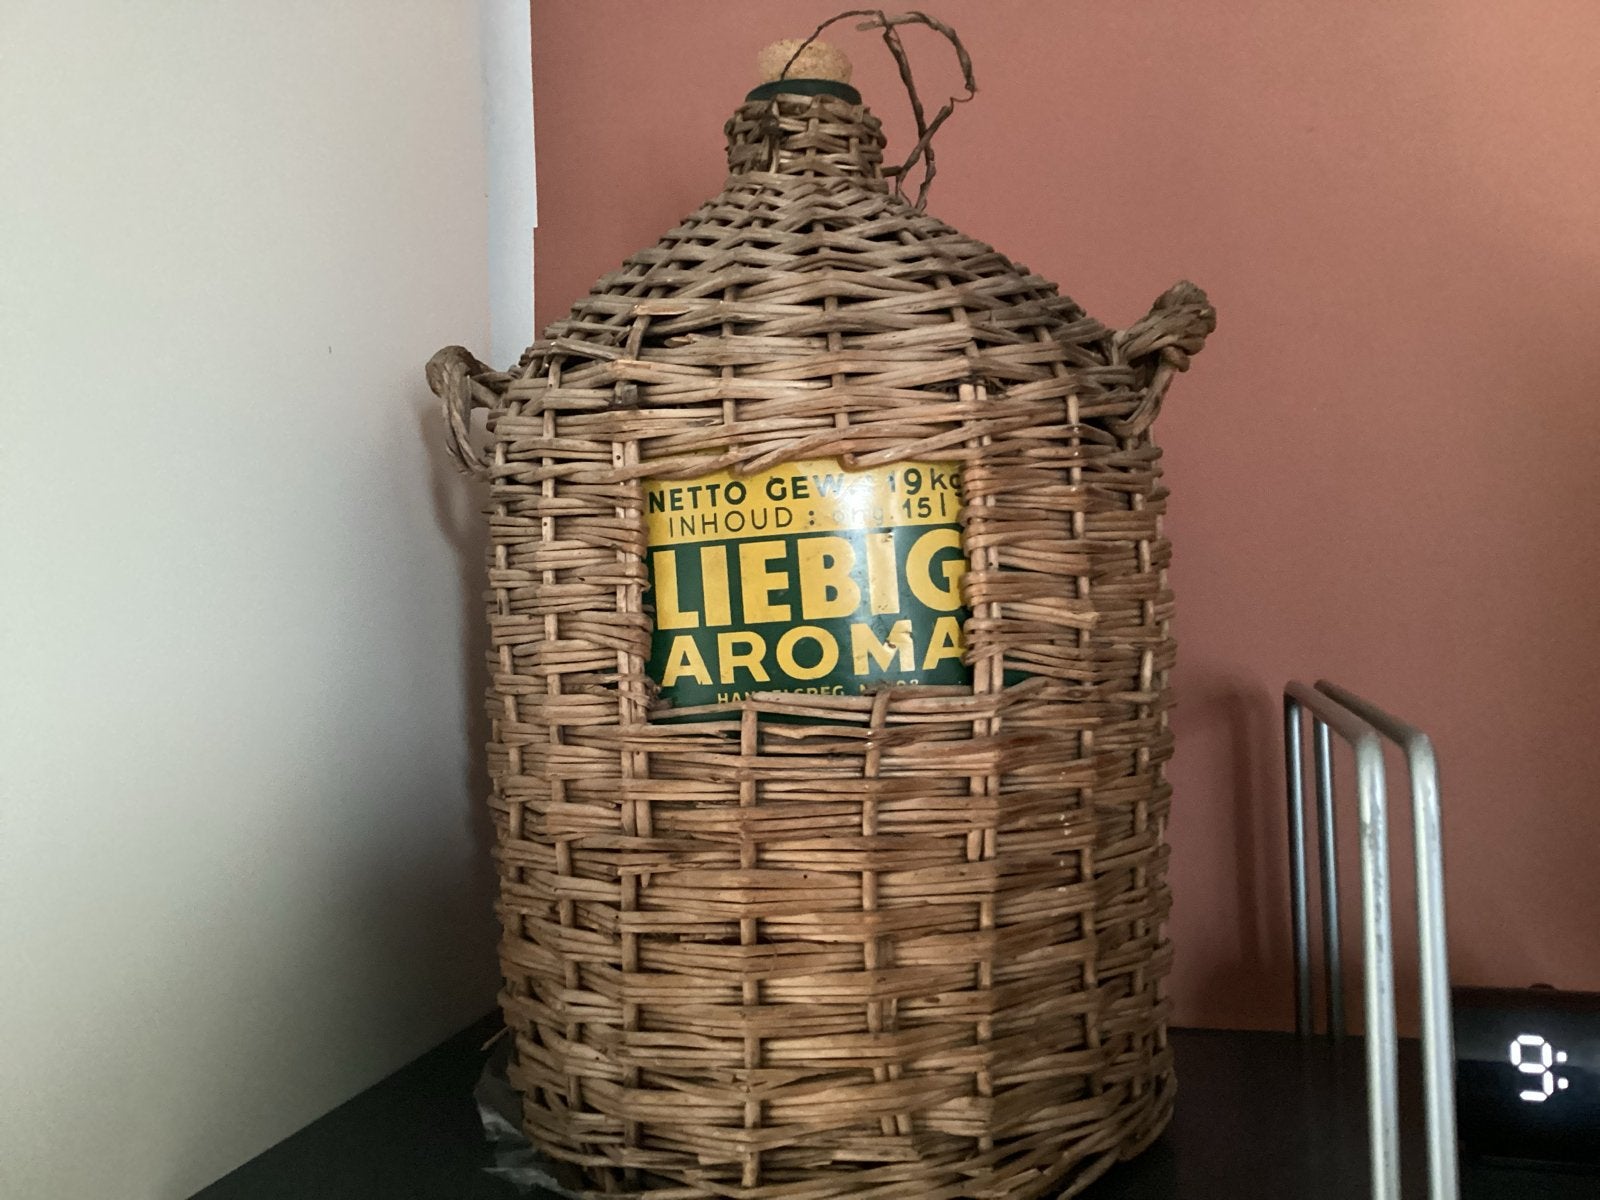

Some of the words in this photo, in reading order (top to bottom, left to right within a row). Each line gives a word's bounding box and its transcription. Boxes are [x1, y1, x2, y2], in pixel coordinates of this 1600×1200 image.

[648, 480, 747, 513] NETTO
[653, 529, 966, 630] LIEBIG
[661, 616, 966, 687] AROMA
